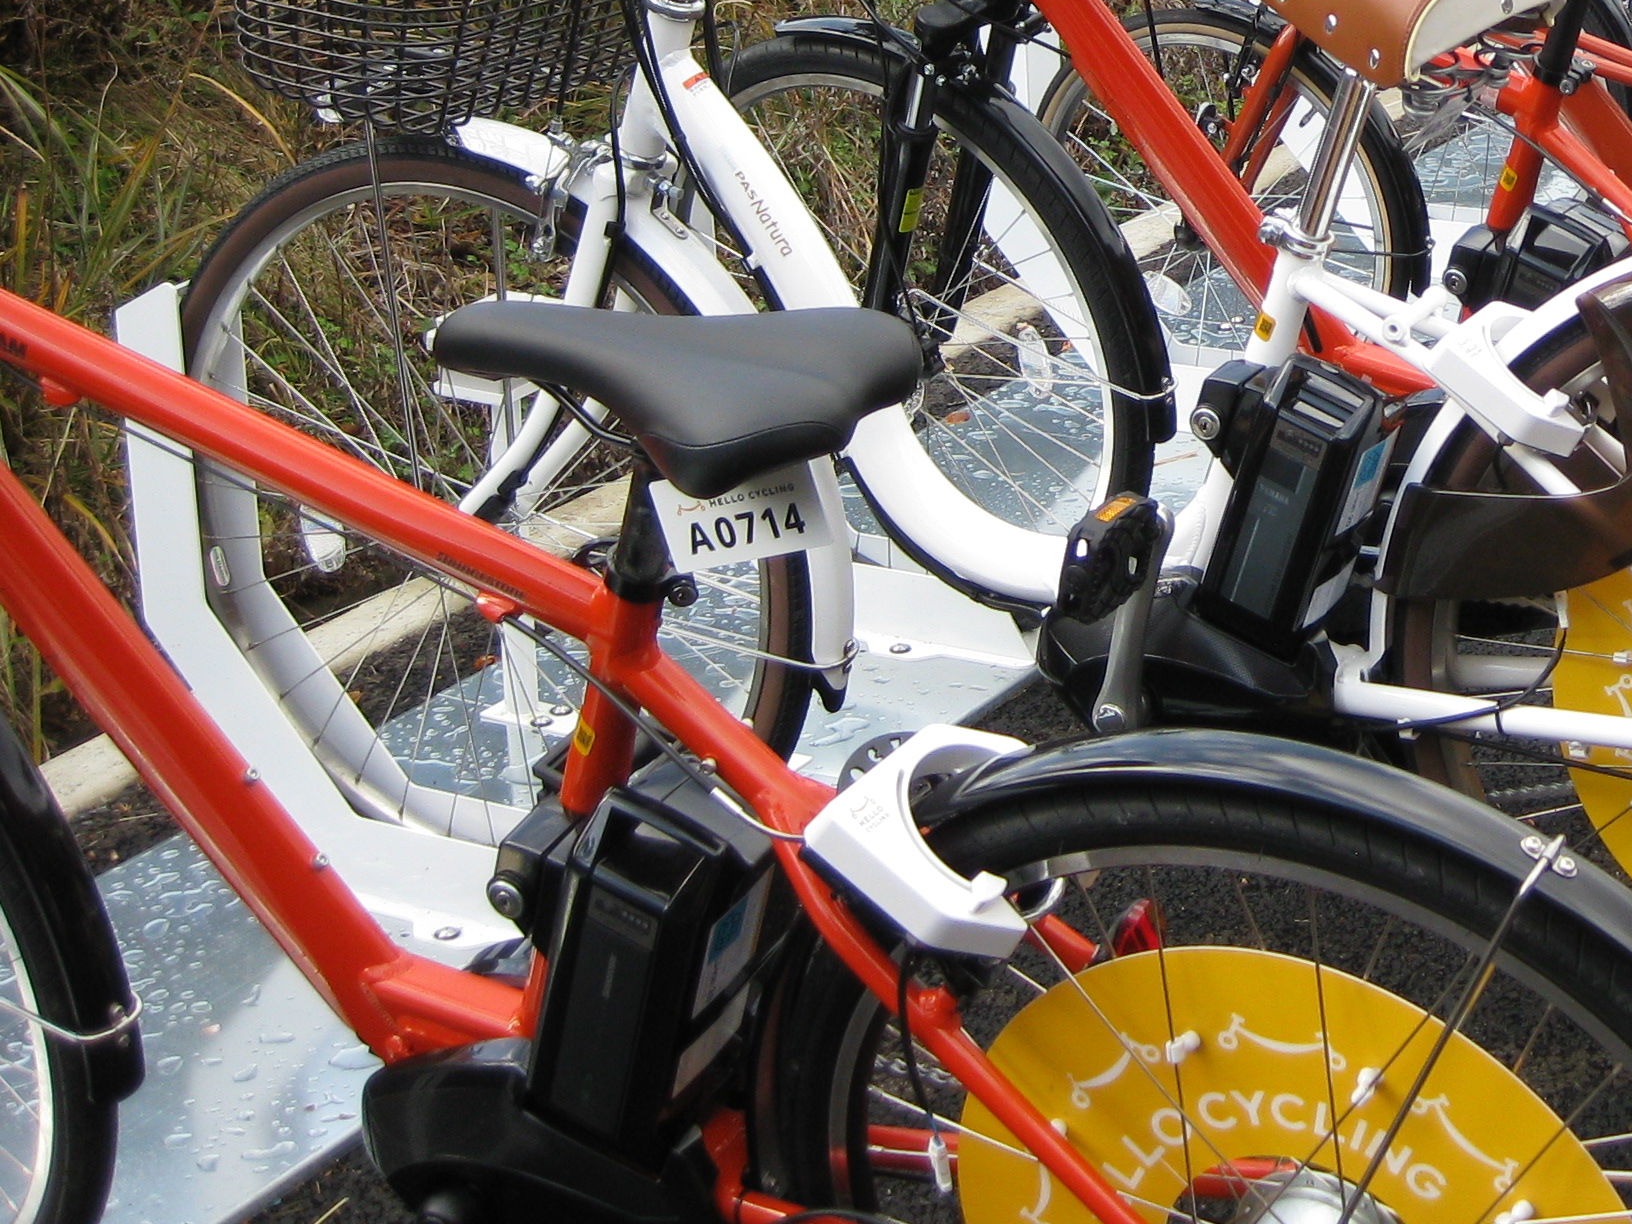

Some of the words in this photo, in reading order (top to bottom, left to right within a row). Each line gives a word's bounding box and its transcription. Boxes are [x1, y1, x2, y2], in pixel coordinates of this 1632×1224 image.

[751, 199, 793, 258] Natura
[709, 493, 745, 508] HELLO
[748, 482, 796, 501] CYCLING
[691, 502, 806, 556] A0714
[1102, 1107, 1192, 1191] LLO
[1198, 1089, 1448, 1201] CYCLING
